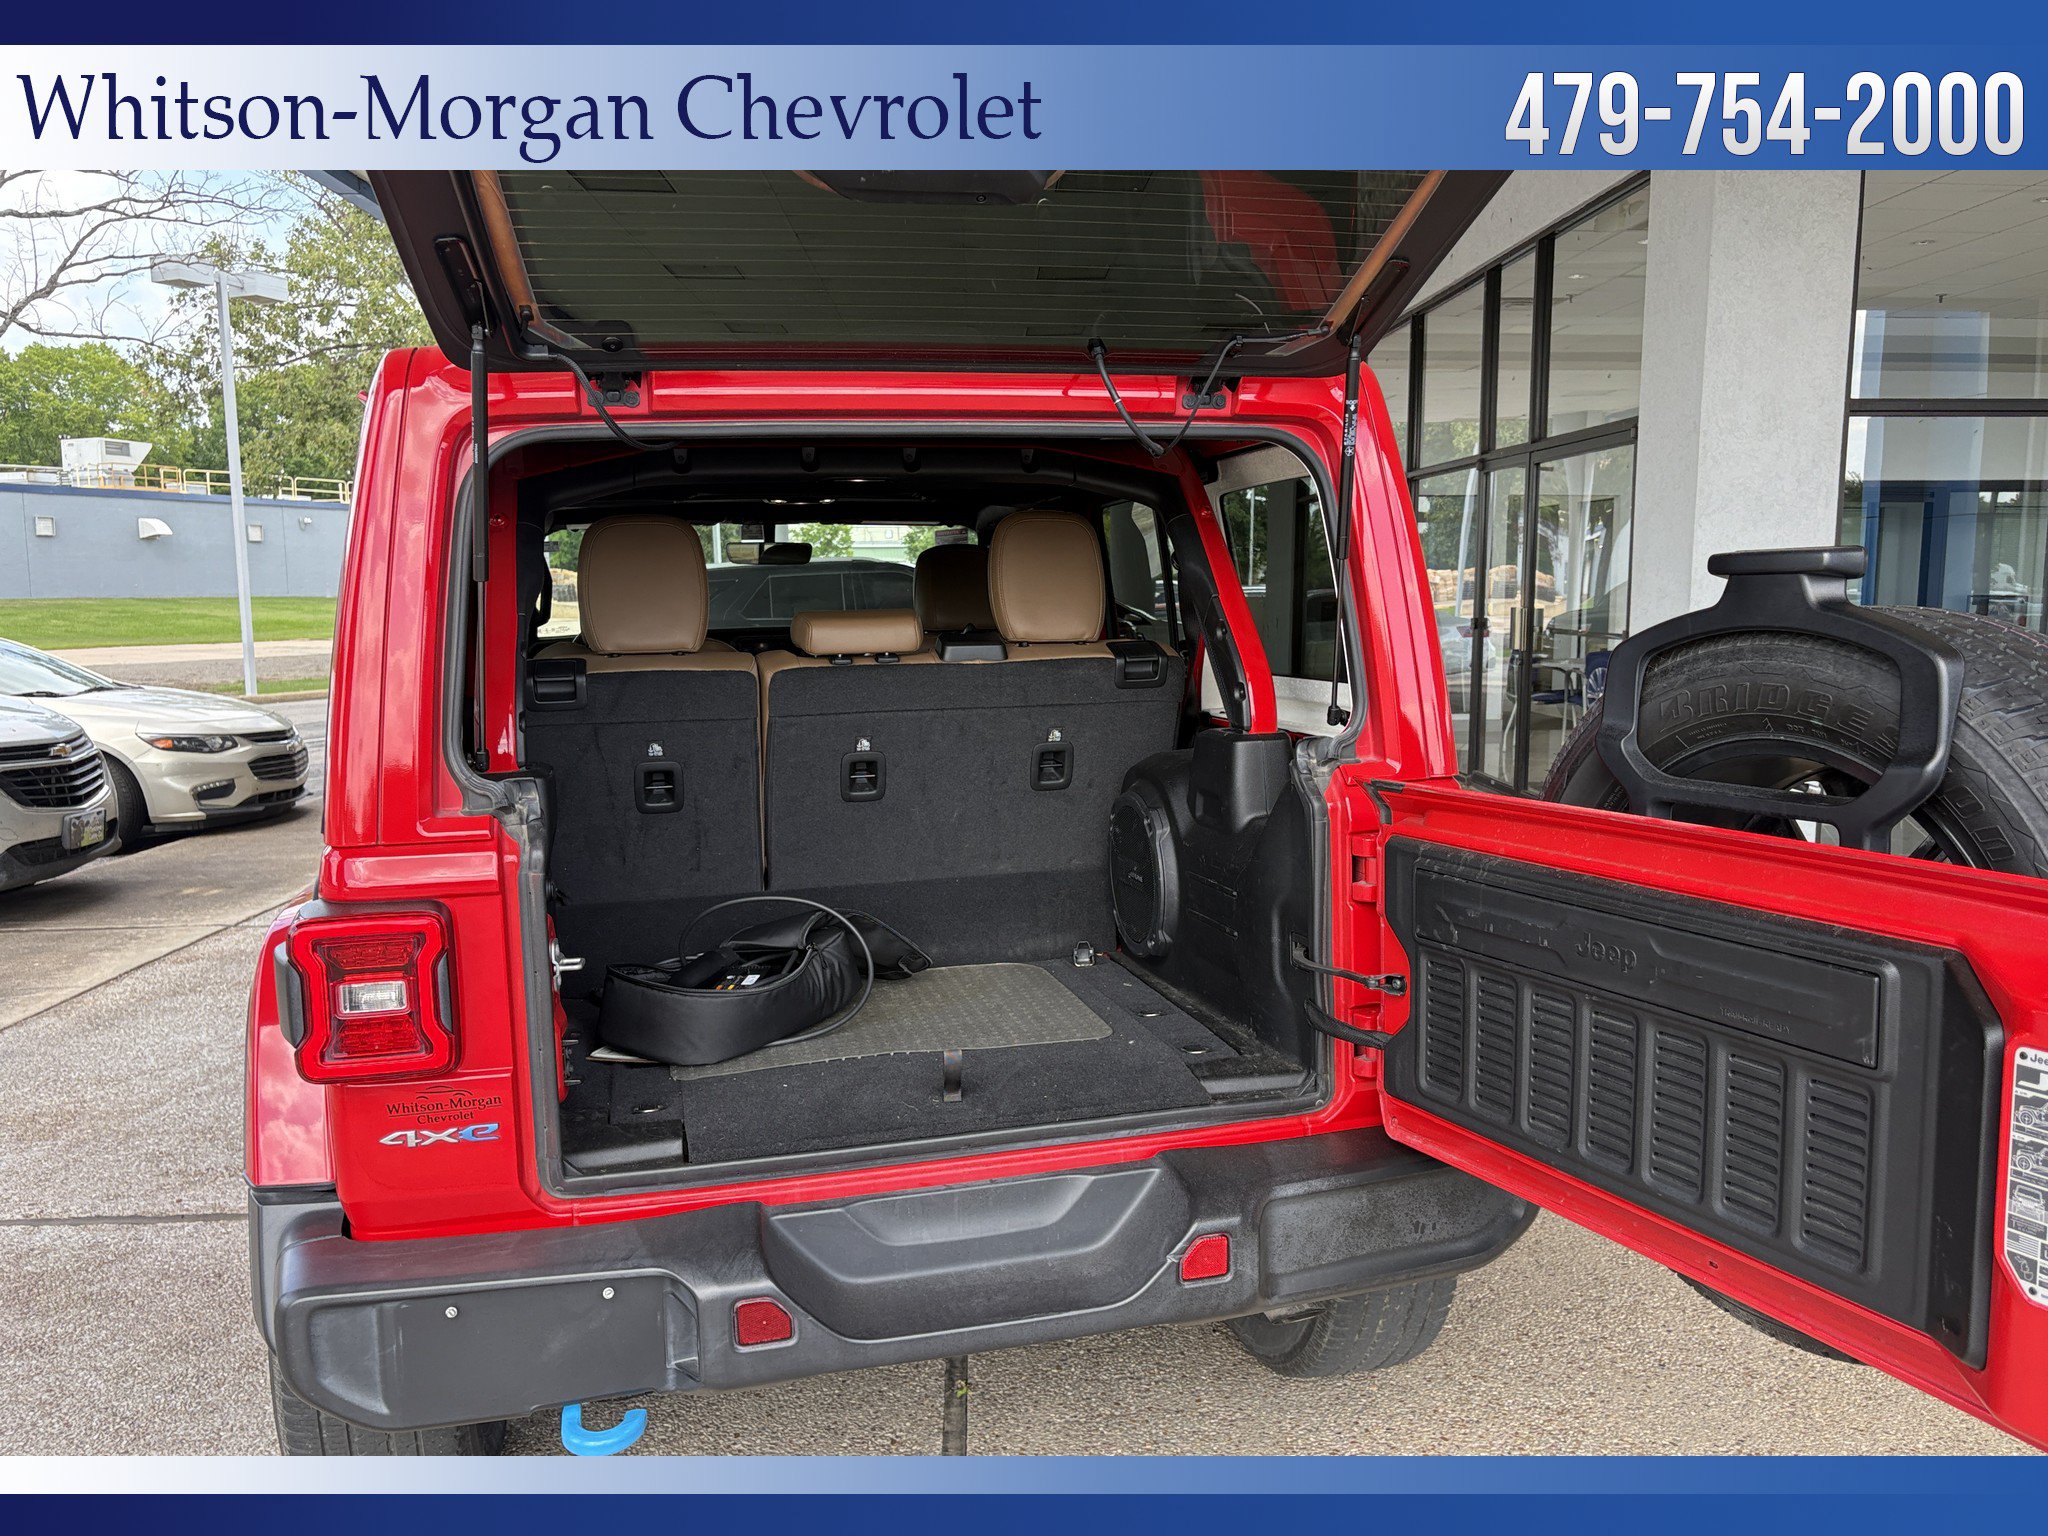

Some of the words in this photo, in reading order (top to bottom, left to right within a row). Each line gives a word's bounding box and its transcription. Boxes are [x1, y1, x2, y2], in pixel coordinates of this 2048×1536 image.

[1575, 928, 1638, 974] Jeep
[2030, 1053, 2048, 1066] Jee
[386, 1096, 503, 1115] Whitson-Morgan
[417, 1111, 475, 1125] Chevrolet
